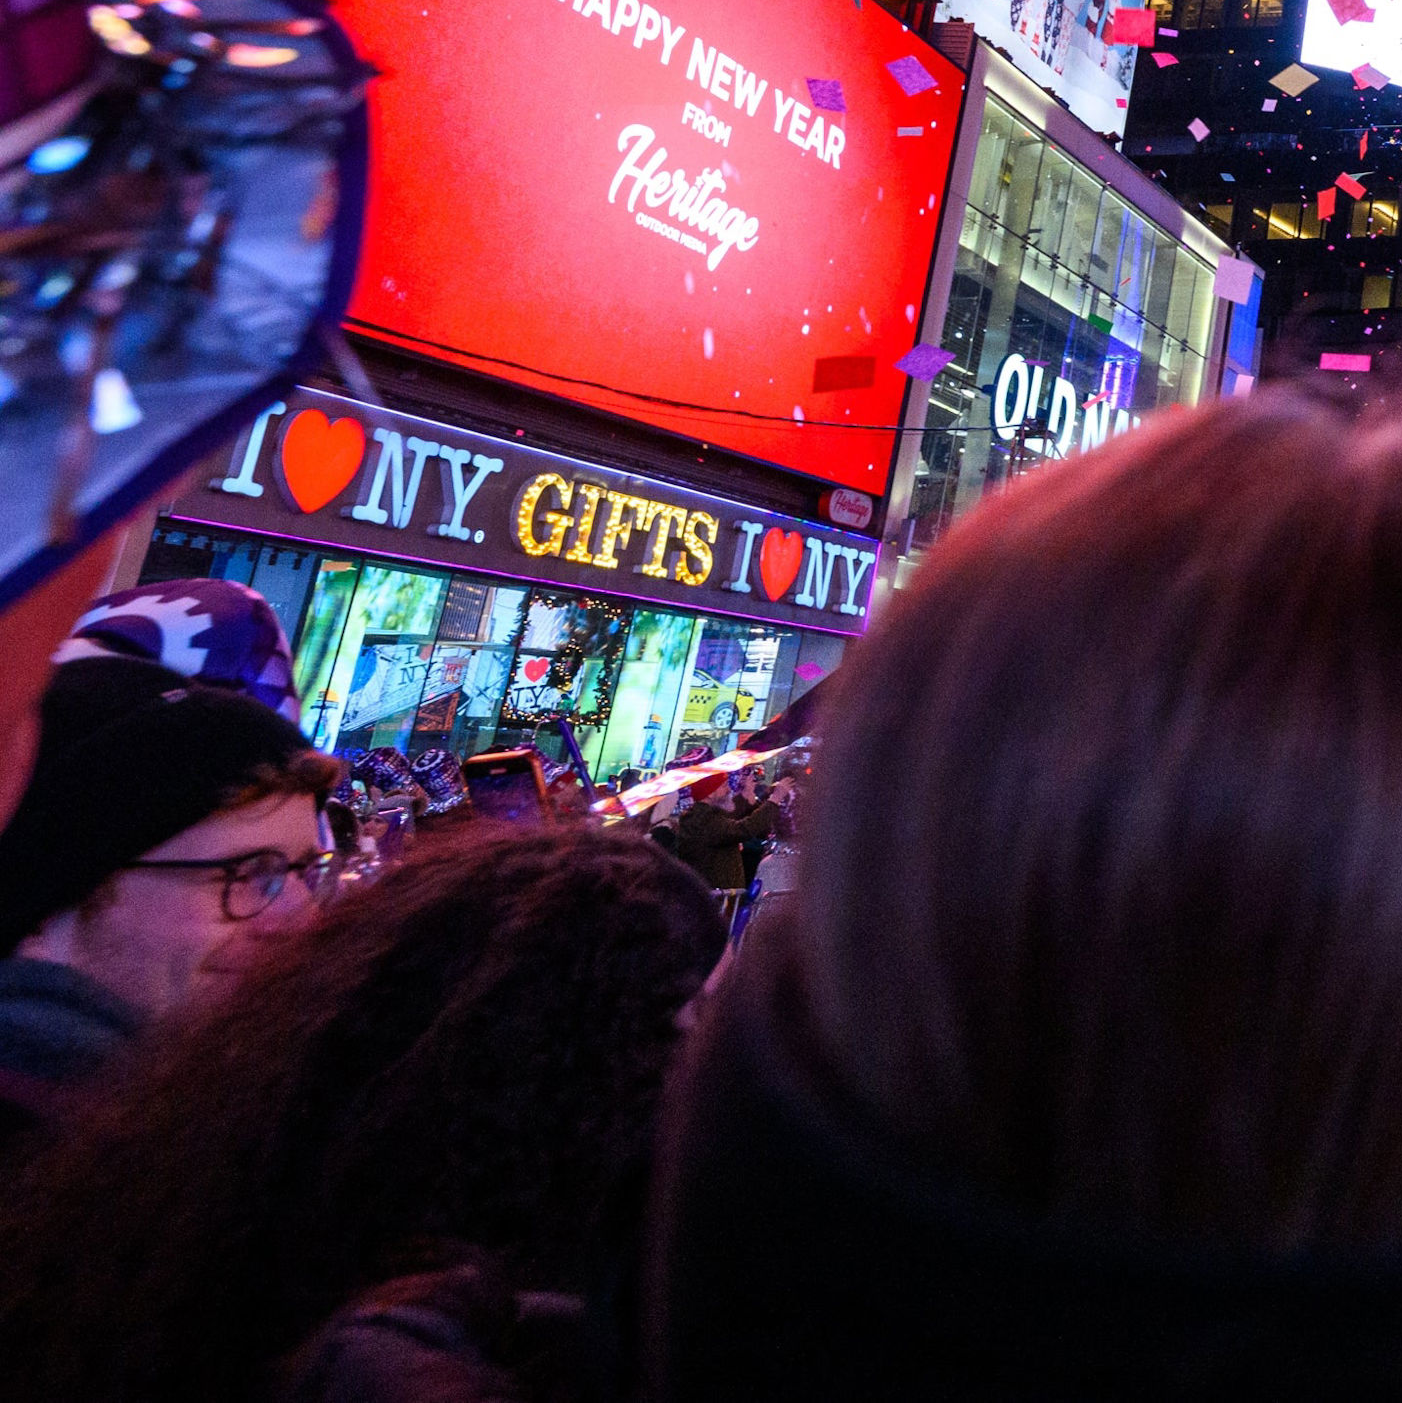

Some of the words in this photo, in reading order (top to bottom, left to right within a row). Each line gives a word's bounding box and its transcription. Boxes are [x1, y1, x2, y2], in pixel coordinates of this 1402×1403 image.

[681, 101, 732, 147] FROM
[686, 37, 769, 117] NEW
[773, 88, 847, 170] YEAR
[608, 123, 760, 271] Heritage
[635, 211, 681, 243] OUTDOOR
[995, 353, 1077, 459] OLD
[518, 473, 720, 586] GIFTS
[731, 520, 762, 593] I
[795, 536, 876, 616] NY
